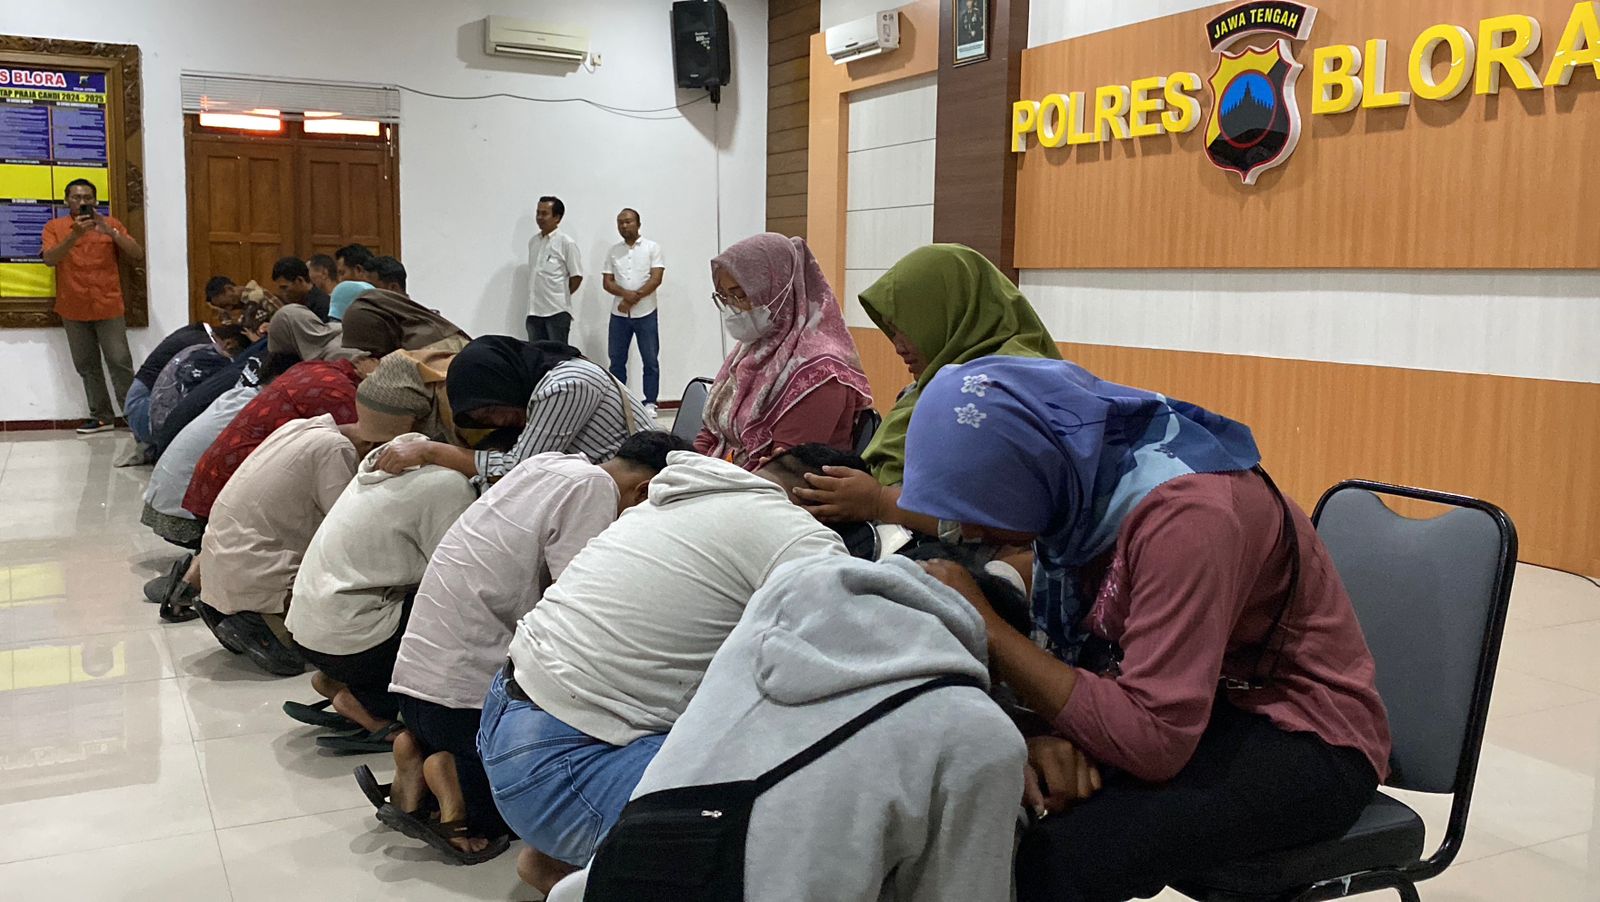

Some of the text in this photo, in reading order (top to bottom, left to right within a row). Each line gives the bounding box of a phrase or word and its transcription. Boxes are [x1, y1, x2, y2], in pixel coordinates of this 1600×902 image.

[1214, 8, 1299, 39] JAWA TENGAH
[12, 70, 67, 87] BLORA
[1011, 1, 1600, 152] POLRES BLORA
[14, 90, 37, 98] PRAJA
[38, 91, 60, 99] CANDI
[61, 93, 80, 101] 2024
